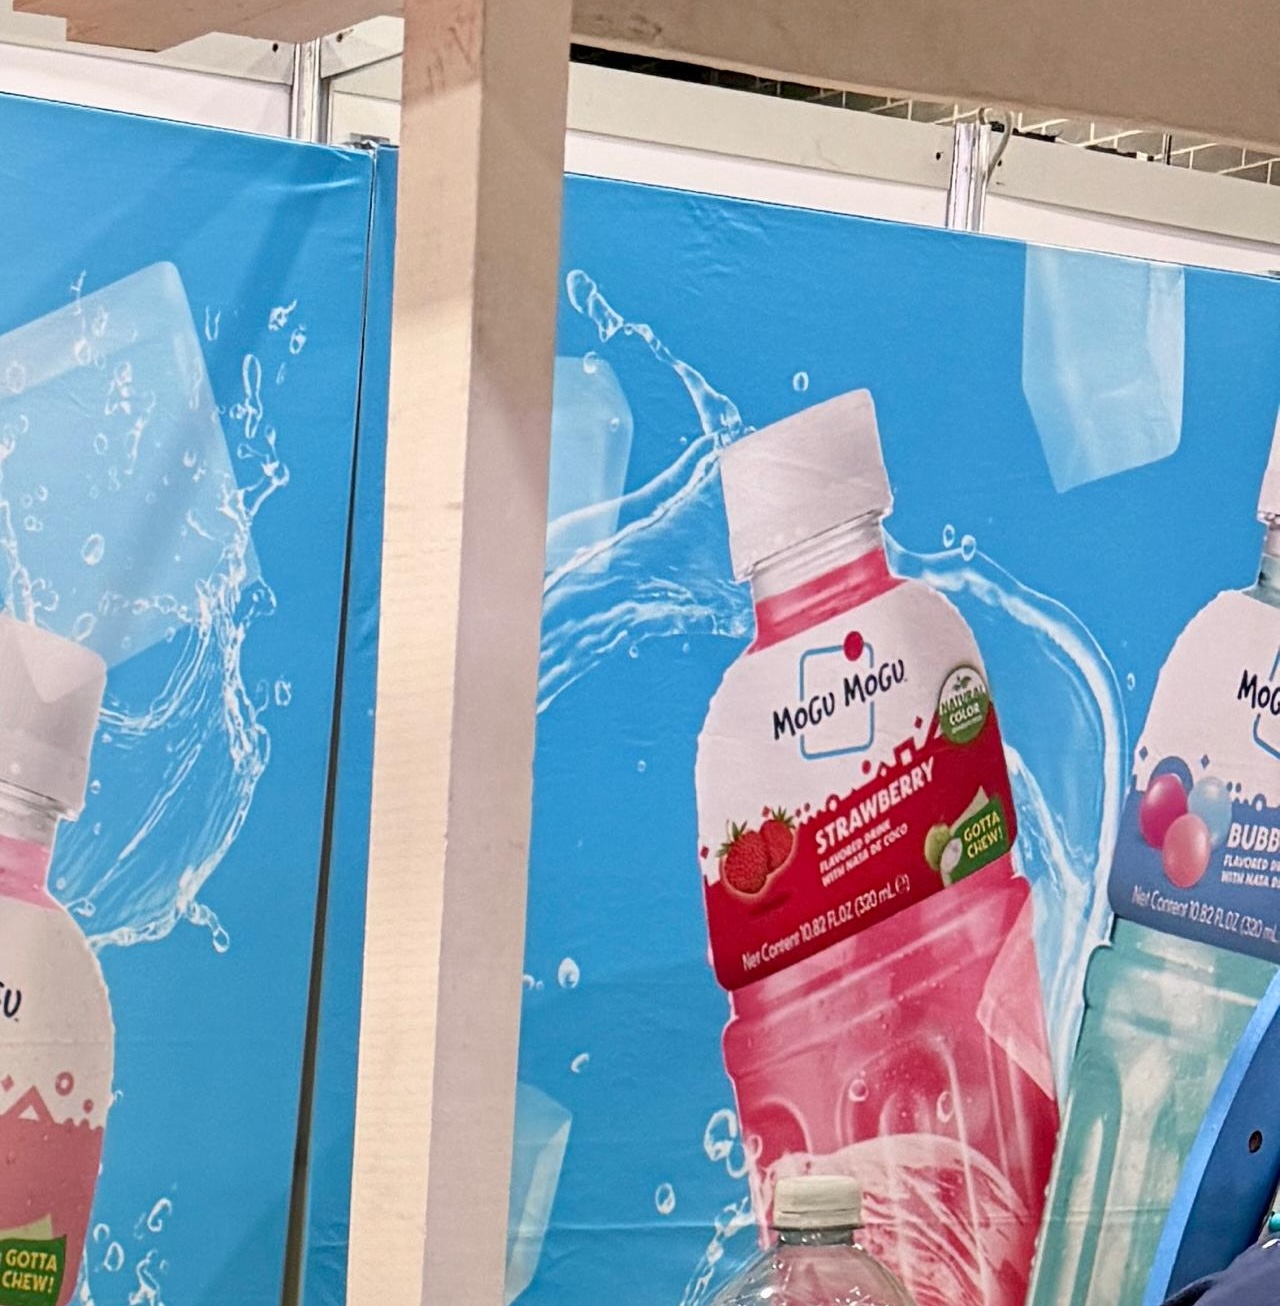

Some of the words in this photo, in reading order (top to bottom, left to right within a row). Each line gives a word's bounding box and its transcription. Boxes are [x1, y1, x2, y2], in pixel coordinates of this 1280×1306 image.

[815, 757, 935, 854] STRAWBERRY
[819, 837, 863, 873] FLAVORED
[6, 1249, 58, 1271] GOTTA
[2, 1270, 55, 1294] CHEW!
